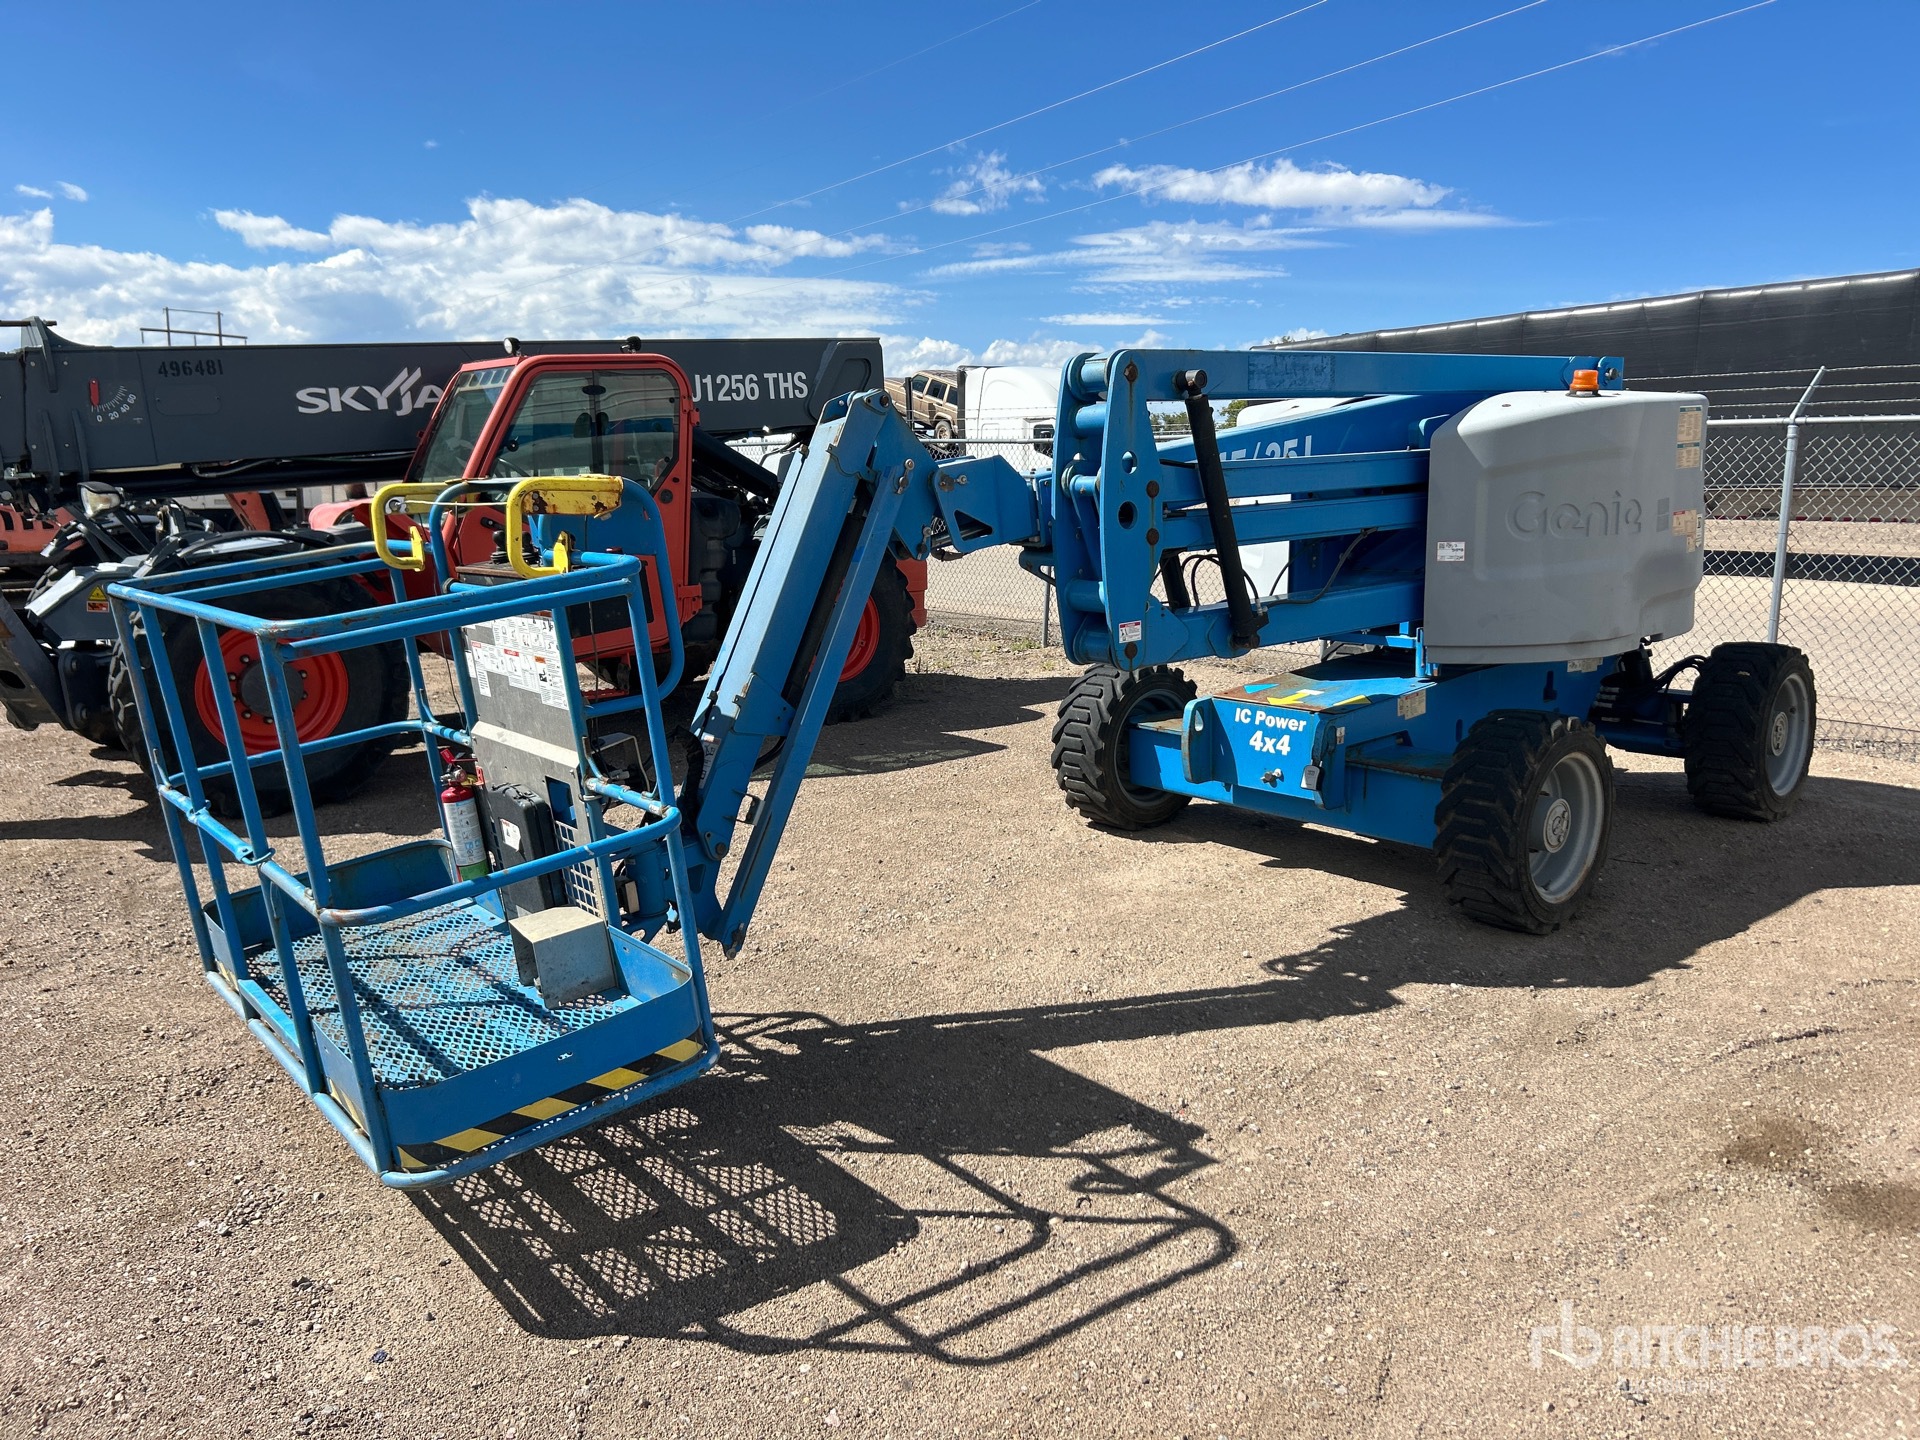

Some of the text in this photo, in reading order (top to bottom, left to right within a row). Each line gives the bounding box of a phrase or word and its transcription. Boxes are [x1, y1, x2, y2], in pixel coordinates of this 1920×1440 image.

[157, 359, 223, 377] 496481
[763, 371, 809, 400] THS
[96, 393, 137, 423] 0 20 40 60
[1505, 489, 1643, 541] Genie
[1234, 707, 1307, 732] IC Power
[1249, 730, 1291, 756] 4x4
